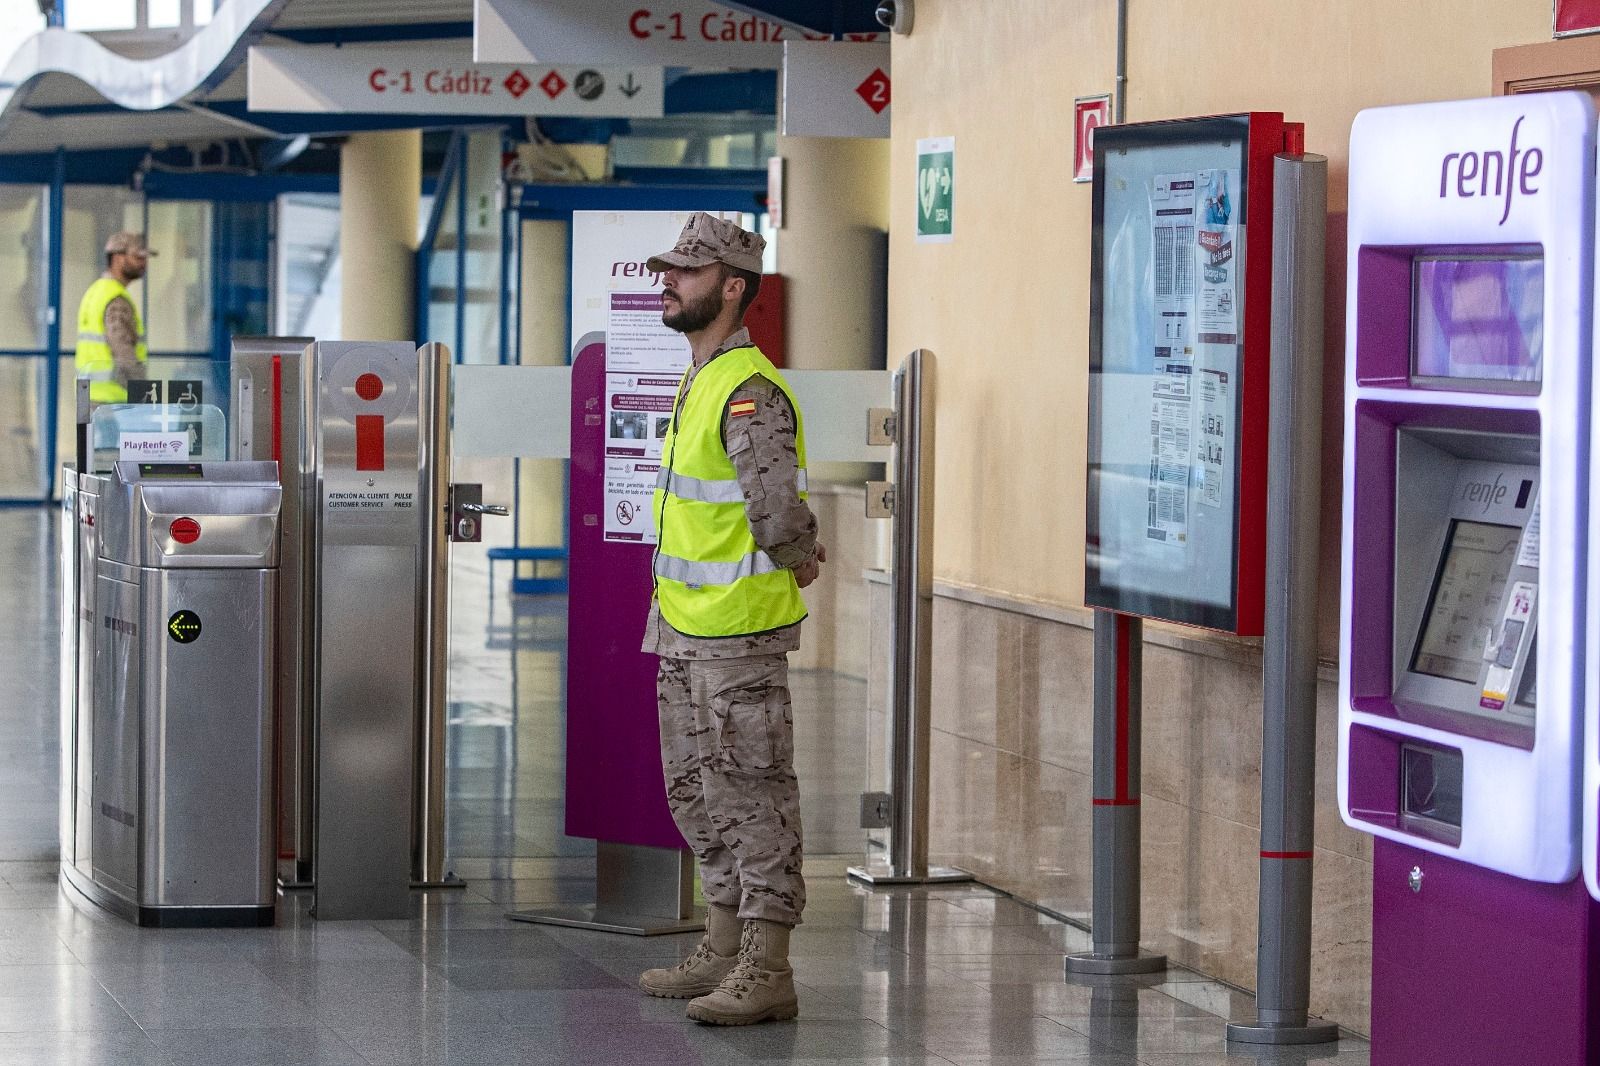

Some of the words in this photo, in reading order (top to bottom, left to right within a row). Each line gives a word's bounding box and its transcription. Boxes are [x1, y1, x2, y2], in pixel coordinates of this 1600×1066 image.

[629, 9, 686, 39] C-1
[700, 10, 784, 42] Cádiz
[368, 68, 414, 92] C-1
[424, 69, 492, 94] Cádiz
[513, 79, 522, 90] 2
[548, 79, 557, 90] 4
[871, 81, 886, 102] 2
[1439, 115, 1543, 226] renfe
[124, 441, 168, 451] PlayRenfe
[1462, 472, 1508, 514] renfe
